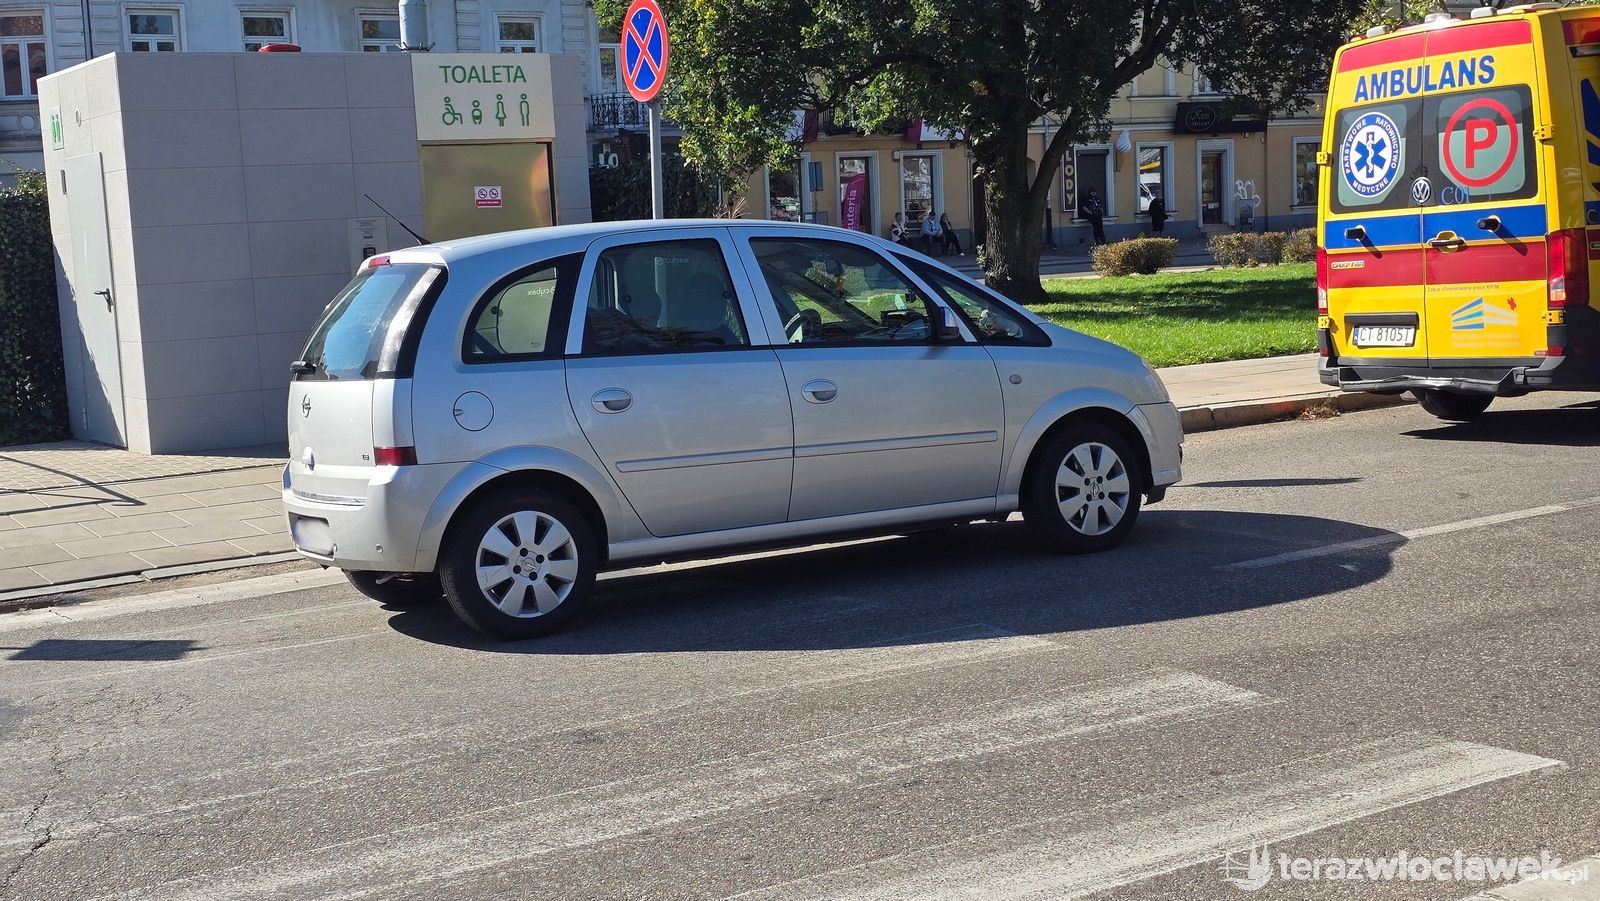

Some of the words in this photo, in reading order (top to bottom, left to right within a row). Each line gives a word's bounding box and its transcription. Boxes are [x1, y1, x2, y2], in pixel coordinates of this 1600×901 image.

[439, 65, 527, 84] TOALETA
[1353, 54, 1496, 103] AMBULANS
[1375, 116, 1400, 170] RATOWNICTWO
[1464, 118, 1498, 169] P
[1064, 150, 1074, 205] LODY
[1352, 177, 1390, 194] MEDYCZNE
[847, 189, 857, 230] uteria
[1360, 327, 1374, 342] CT
